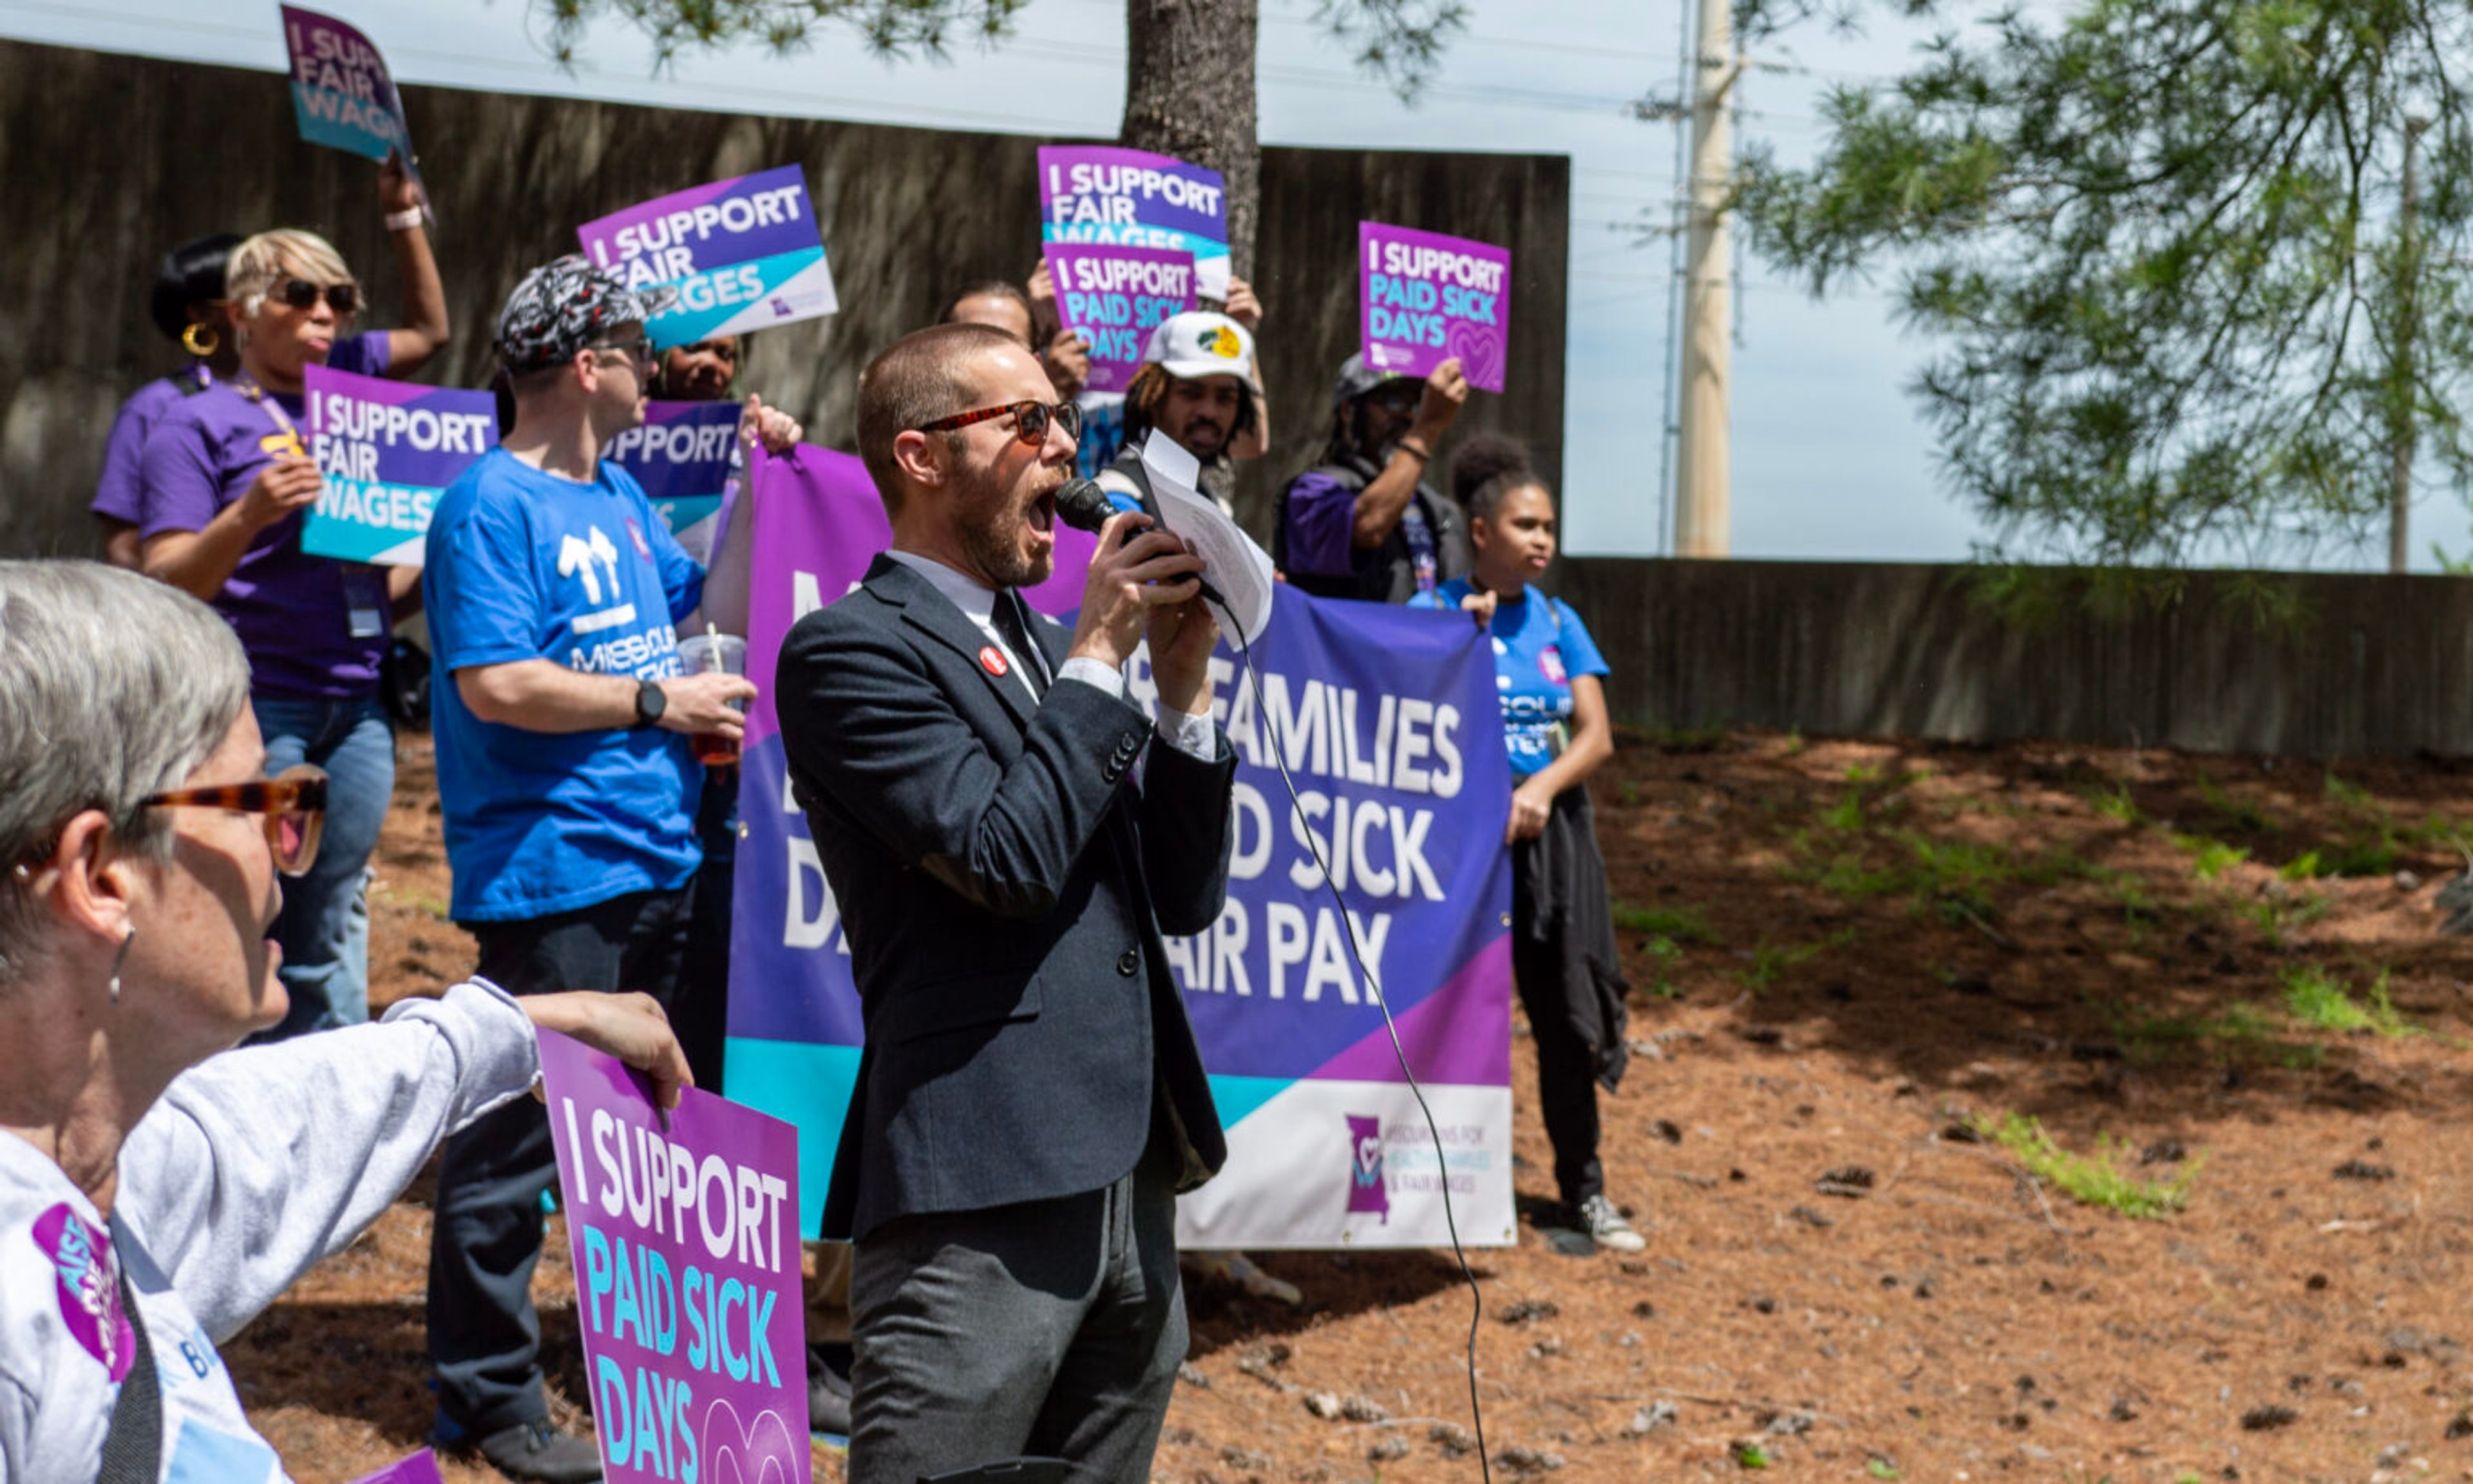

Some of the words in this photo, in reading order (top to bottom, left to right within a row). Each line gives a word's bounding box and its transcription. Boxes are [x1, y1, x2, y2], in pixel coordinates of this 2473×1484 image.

[297, 55, 377, 103] FAIR
[1048, 164, 1061, 195] I
[1069, 163, 1221, 218] SUPPORT
[1051, 194, 1137, 226] FAIR
[592, 238, 609, 269] I
[614, 184, 802, 261] SUPPORT
[1056, 258, 1072, 290] I
[1074, 258, 1191, 298] SUPPORT
[1368, 238, 1379, 272] I
[1384, 241, 1505, 294] SUPPORT
[1064, 292, 1132, 326] PAID
[1369, 273, 1437, 312] PAID
[1442, 284, 1497, 326] SICK
[1369, 306, 1446, 348] DAYS
[312, 390, 321, 431] I
[326, 393, 491, 455] SUPPORT
[313, 433, 380, 484] FAIR
[1207, 655, 1464, 800] FAMILIES
[1289, 790, 1446, 902] SICK
[1267, 901, 1392, 1006] PAY
[562, 1097, 589, 1205] I
[591, 1108, 788, 1273] SUPPORT
[583, 1225, 677, 1356] PAID
[683, 1265, 782, 1389] SICK
[596, 1353, 699, 1484] DAYS
